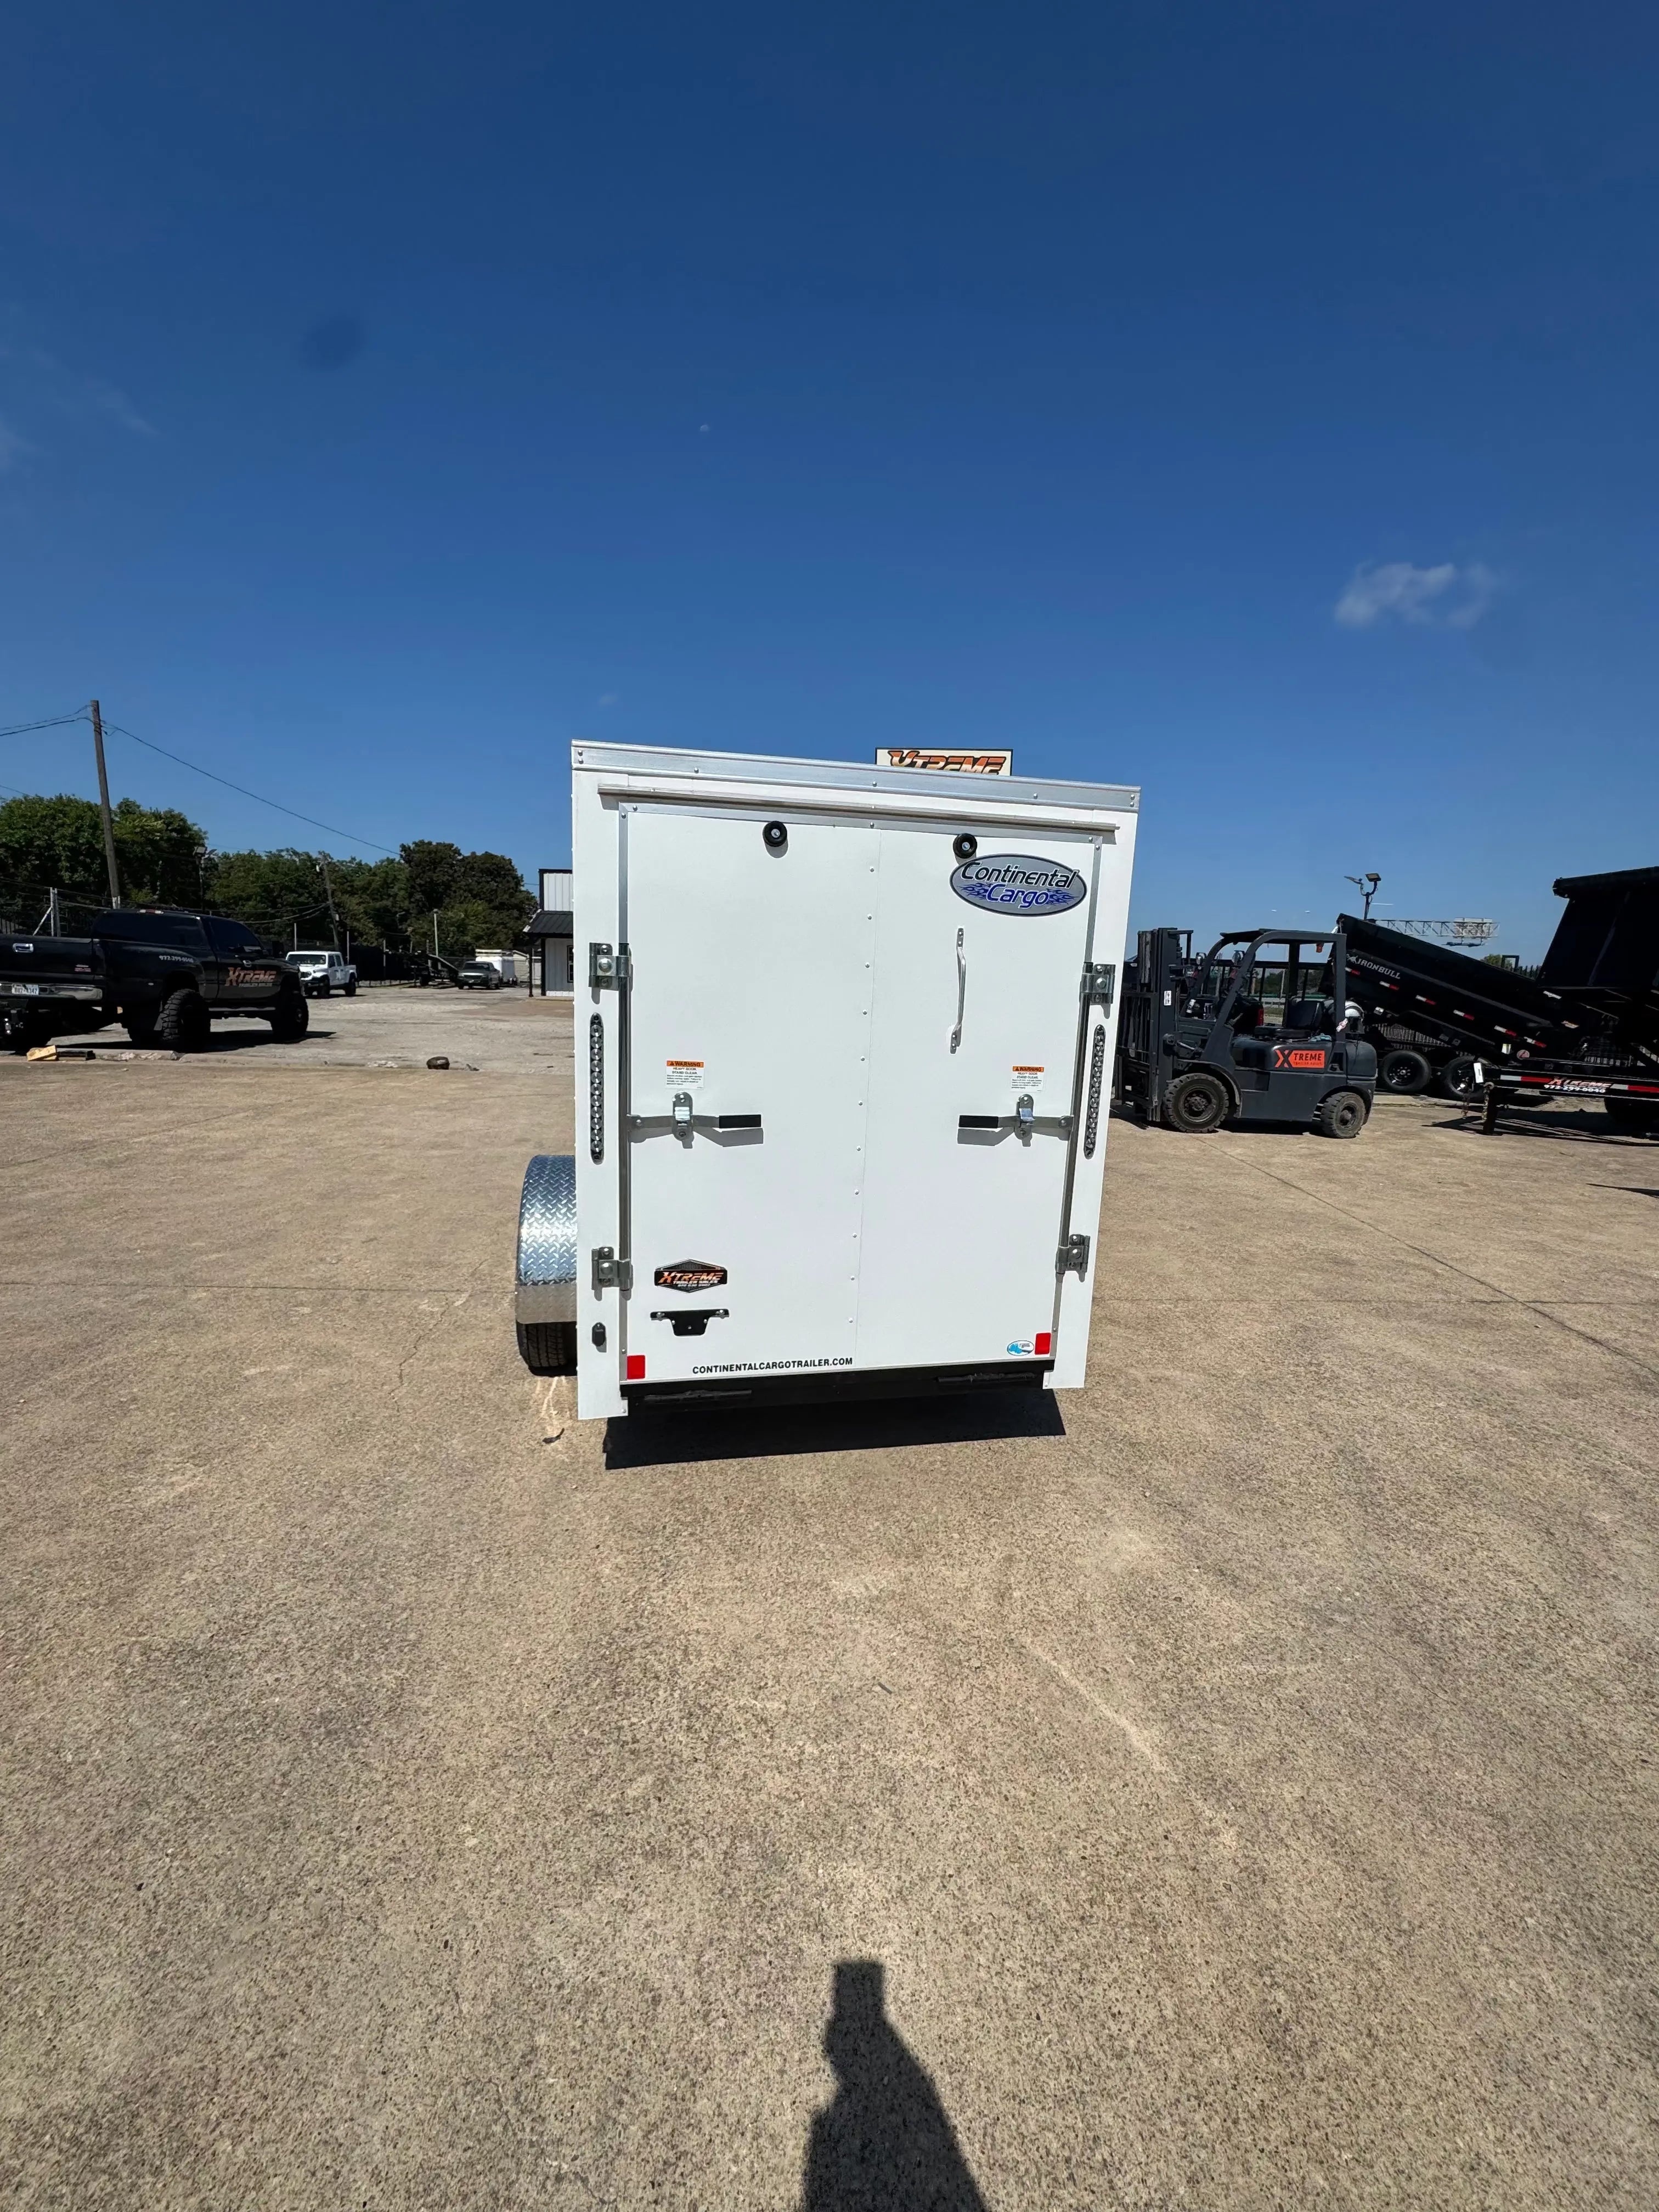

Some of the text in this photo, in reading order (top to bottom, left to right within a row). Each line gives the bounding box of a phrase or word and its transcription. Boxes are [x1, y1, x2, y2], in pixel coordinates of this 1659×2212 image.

[961, 861, 1080, 889] Continental
[987, 884, 1049, 909] Cargo
[224, 967, 276, 986] XTREME
[1357, 958, 1401, 979] IRONBULL
[658, 1271, 724, 1283] XTREME
[692, 1357, 853, 1374] CONTINENTALCARGOTRAILER.COM
